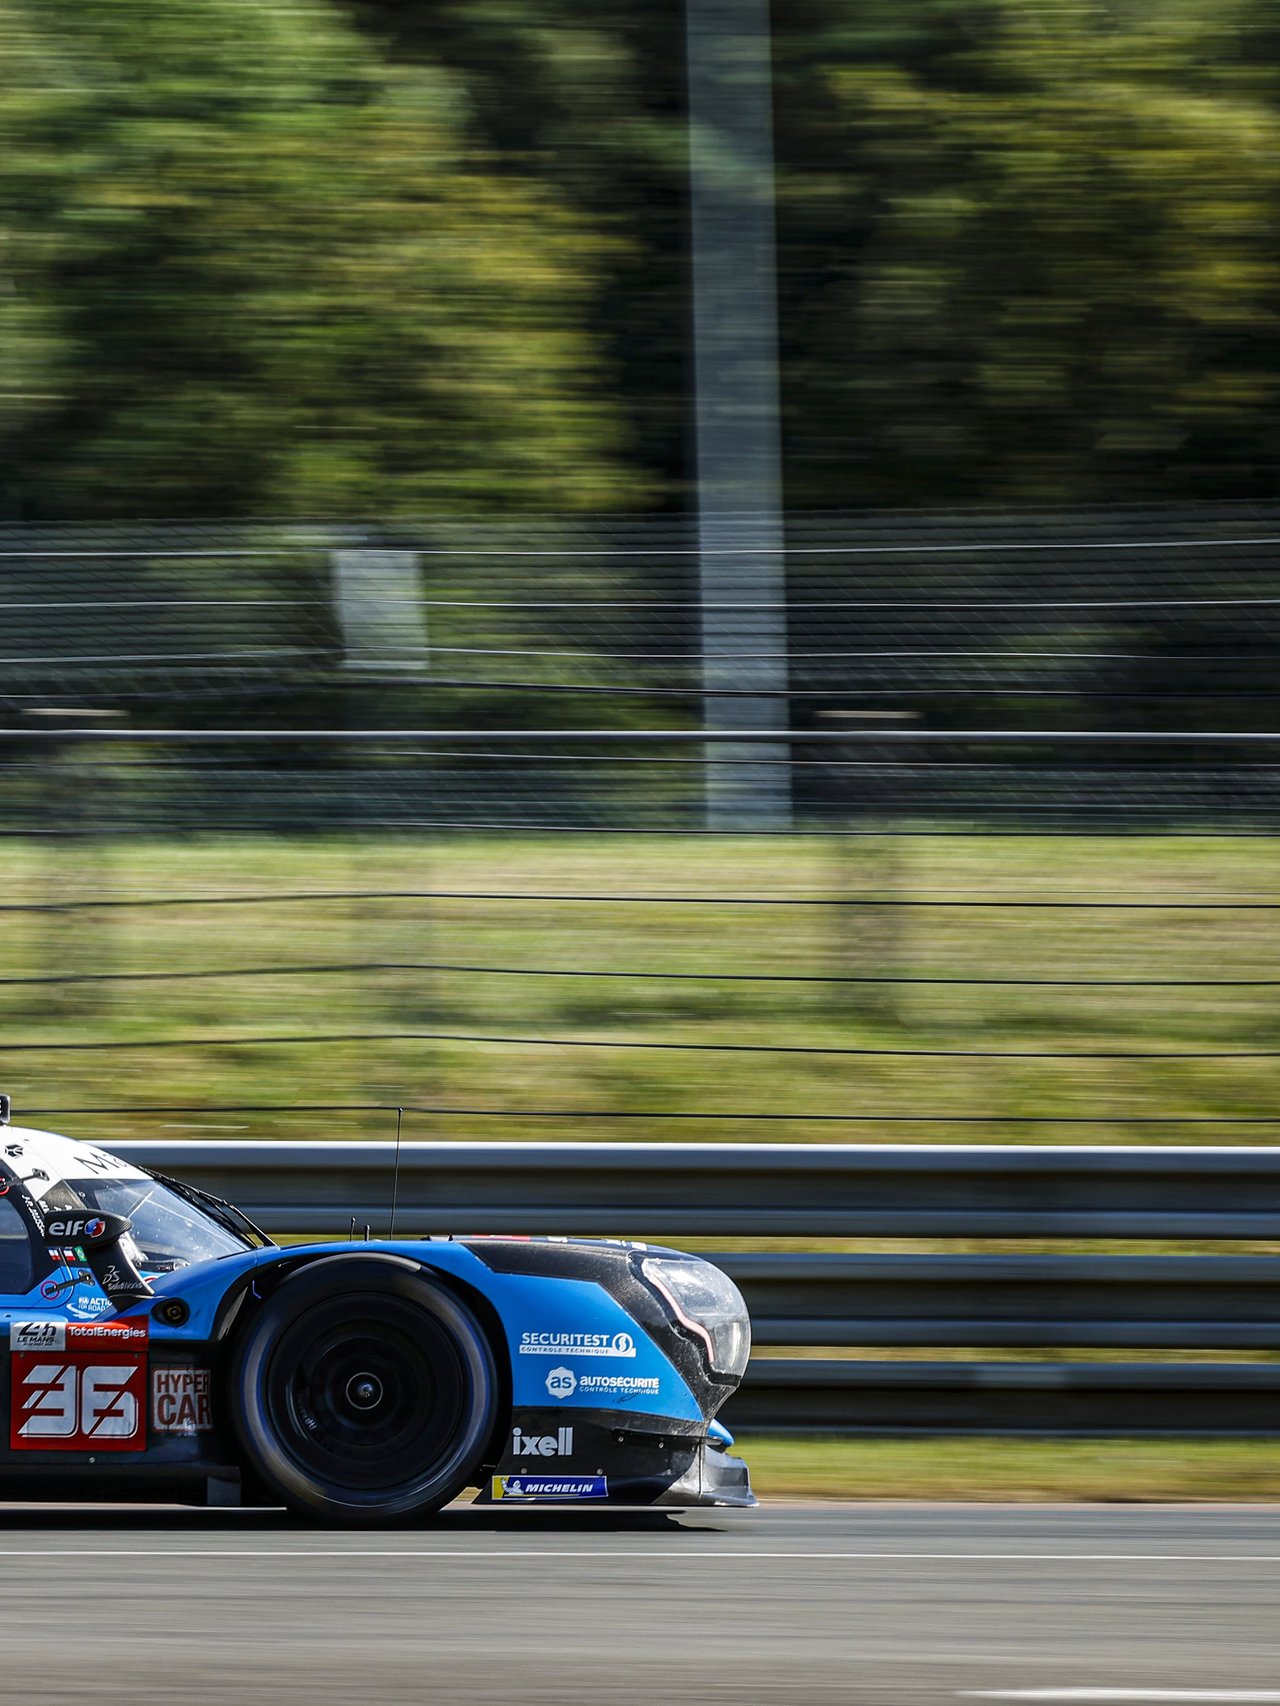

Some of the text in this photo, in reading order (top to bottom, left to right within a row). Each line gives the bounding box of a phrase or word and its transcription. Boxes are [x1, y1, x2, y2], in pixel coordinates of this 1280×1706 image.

[48, 1220, 85, 1237] elf
[67, 1326, 146, 1340] TotalEnergies
[521, 1332, 611, 1347] SECURITEST
[17, 1364, 140, 1440] 36
[157, 1393, 211, 1426] CAR
[512, 1426, 574, 1457] ixell
[524, 1483, 594, 1493] MICHELIN
